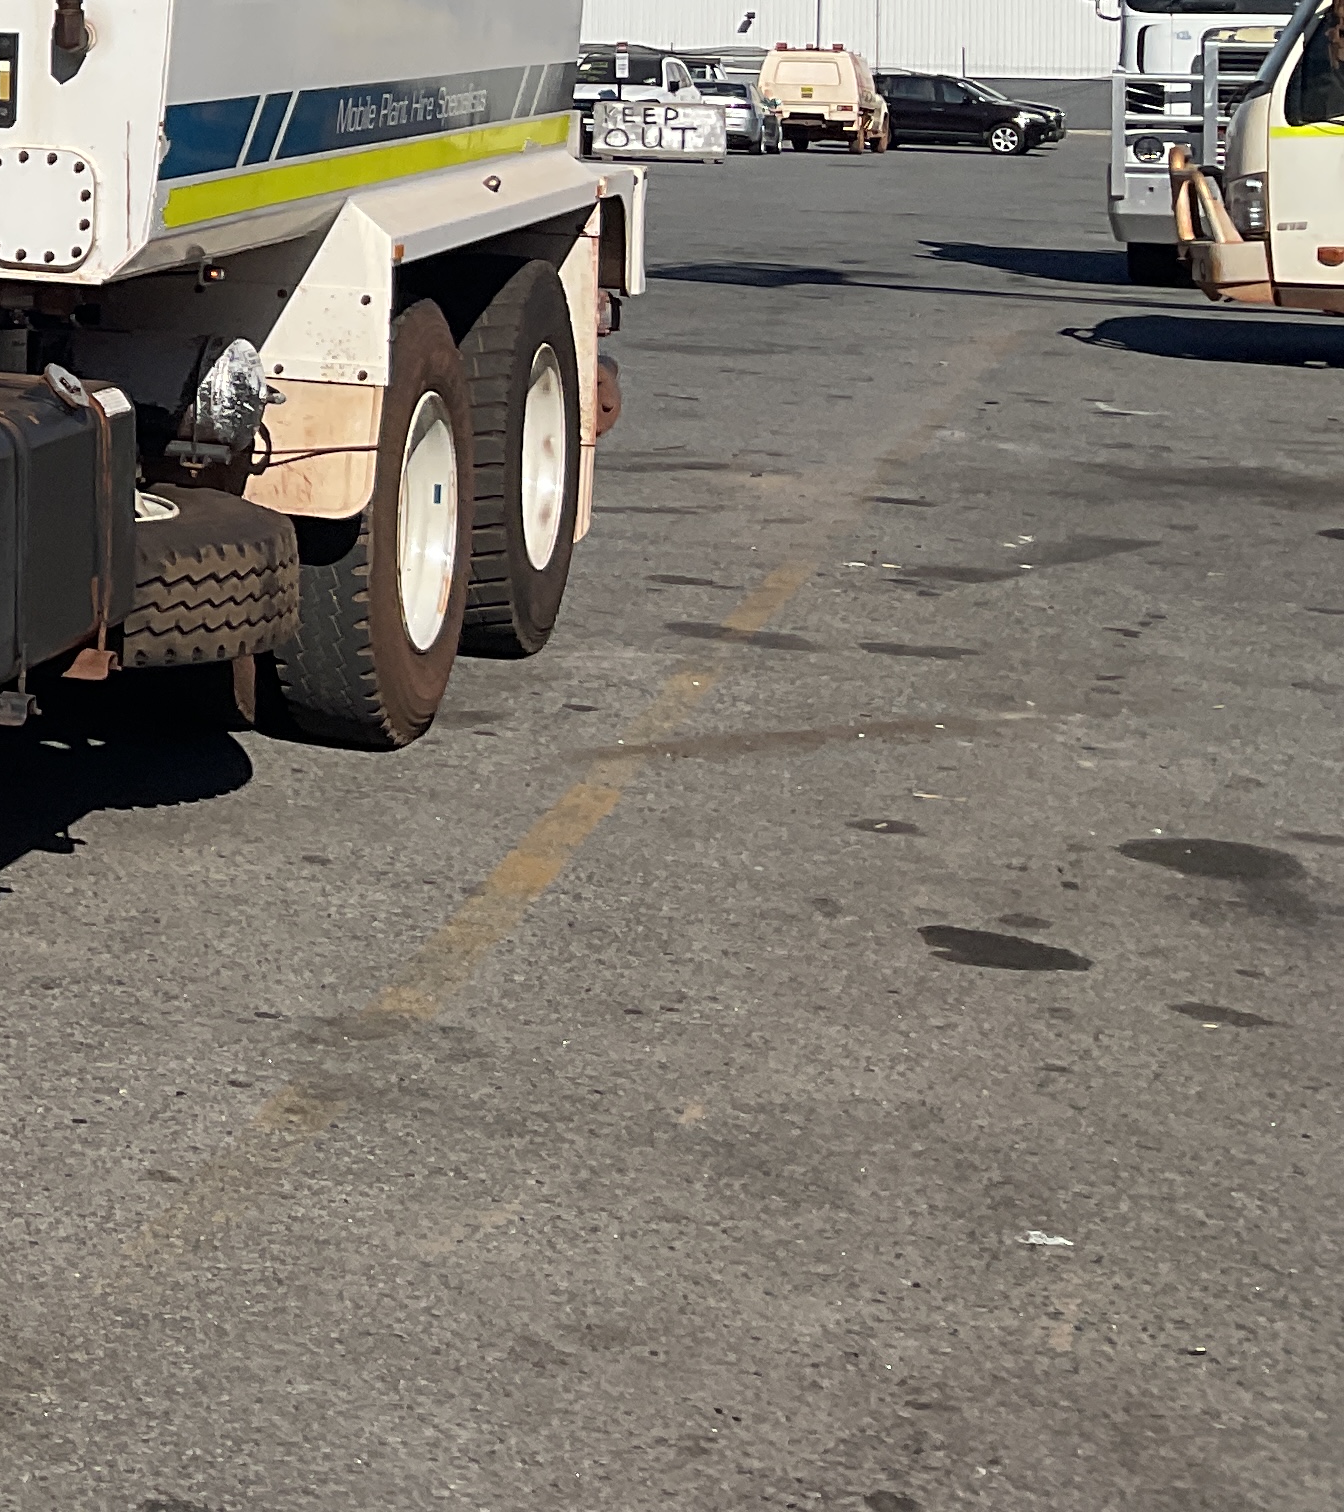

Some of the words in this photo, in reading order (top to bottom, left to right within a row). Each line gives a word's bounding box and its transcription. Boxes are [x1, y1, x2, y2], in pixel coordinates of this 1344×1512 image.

[336, 95, 377, 134] Mobile
[379, 93, 409, 128] Plant
[410, 89, 434, 122] Hire
[604, 105, 680, 127] KEEP
[604, 126, 698, 150] OUT
